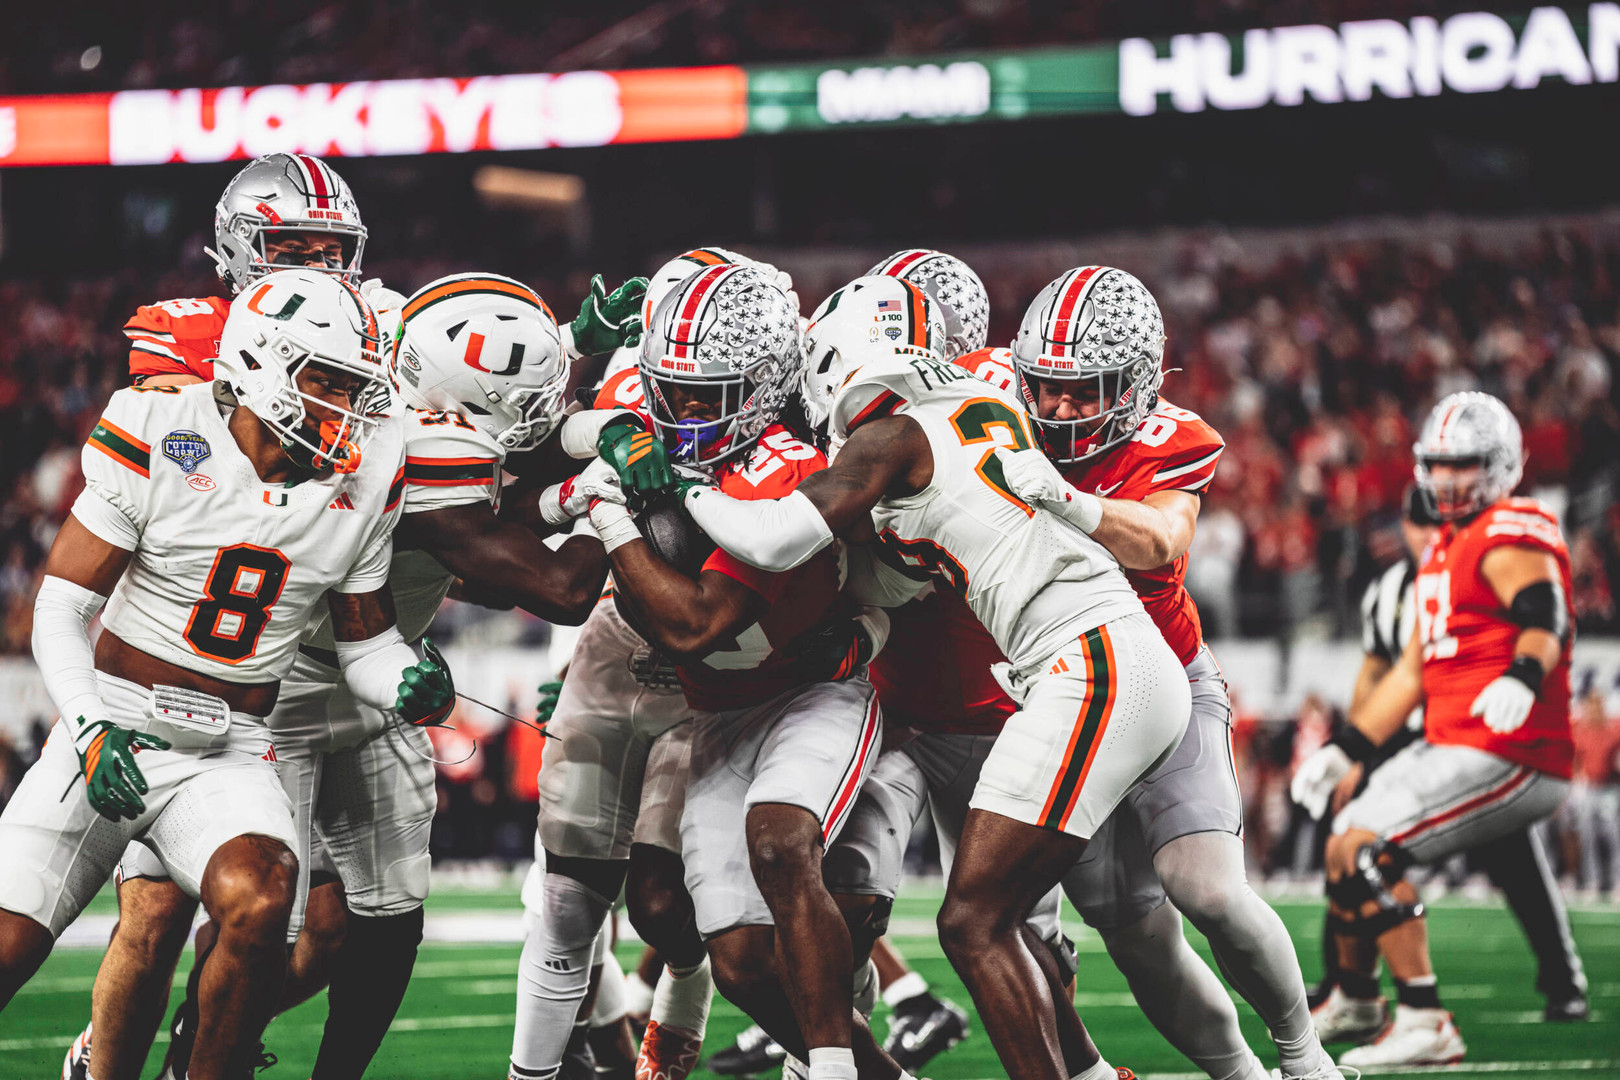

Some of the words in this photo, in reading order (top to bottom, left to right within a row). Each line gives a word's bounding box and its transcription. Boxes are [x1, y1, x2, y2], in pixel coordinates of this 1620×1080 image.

[108, 71, 622, 165] BUCKEYES
[308, 210, 324, 219] OHIO
[247, 284, 306, 321] U
[464, 332, 526, 376] U
[676, 362, 695, 373] STATE
[1054, 361, 1074, 369] STATE
[909, 359, 975, 391] FRE
[166, 441, 208, 455] COTTON
[174, 449, 201, 458] BOWL
[189, 477, 213, 487] ACC
[263, 490, 288, 507] U
[183, 542, 292, 665] 8
